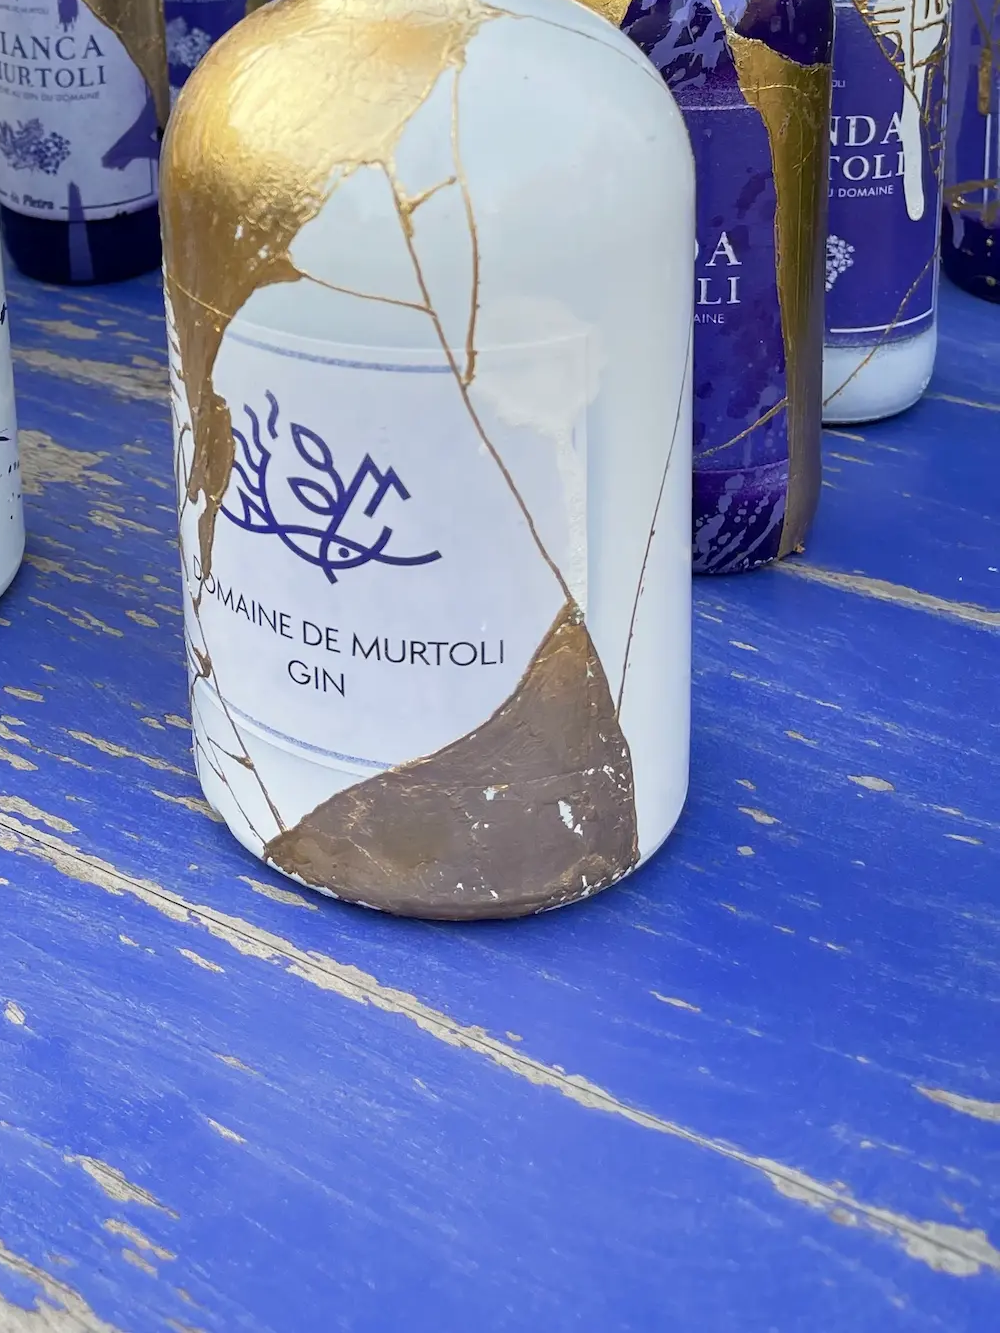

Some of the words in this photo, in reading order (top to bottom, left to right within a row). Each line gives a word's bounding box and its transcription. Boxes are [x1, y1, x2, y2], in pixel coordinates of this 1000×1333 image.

[838, 184, 895, 198] DOMAINE
[193, 553, 294, 640] DOMAINE
[302, 620, 341, 654] DE
[352, 632, 504, 667] MURTOLI
[287, 659, 346, 697] GIN
